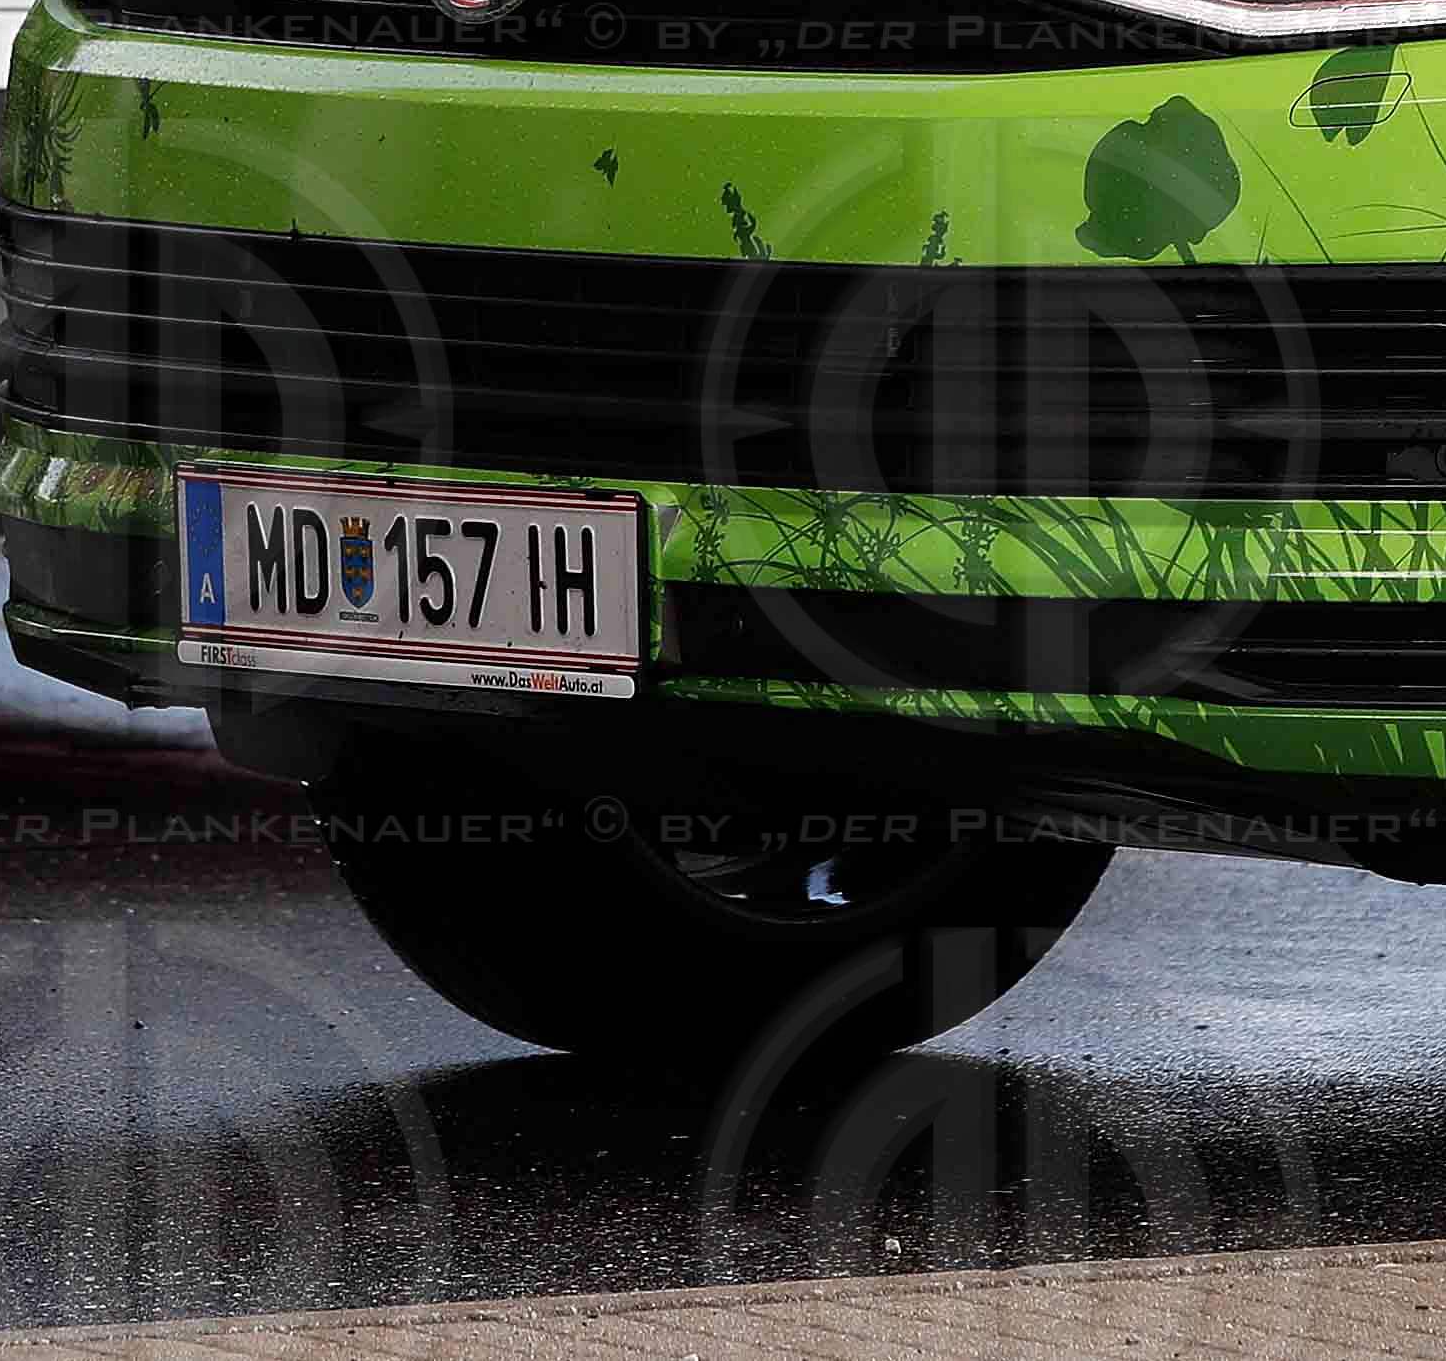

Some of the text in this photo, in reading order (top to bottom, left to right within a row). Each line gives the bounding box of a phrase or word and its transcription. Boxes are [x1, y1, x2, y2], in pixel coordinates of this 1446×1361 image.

[246, 503, 596, 637] MD 157 IH
[199, 572, 216, 604] A
[471, 671, 604, 694] www.DasWeltAuto.at
